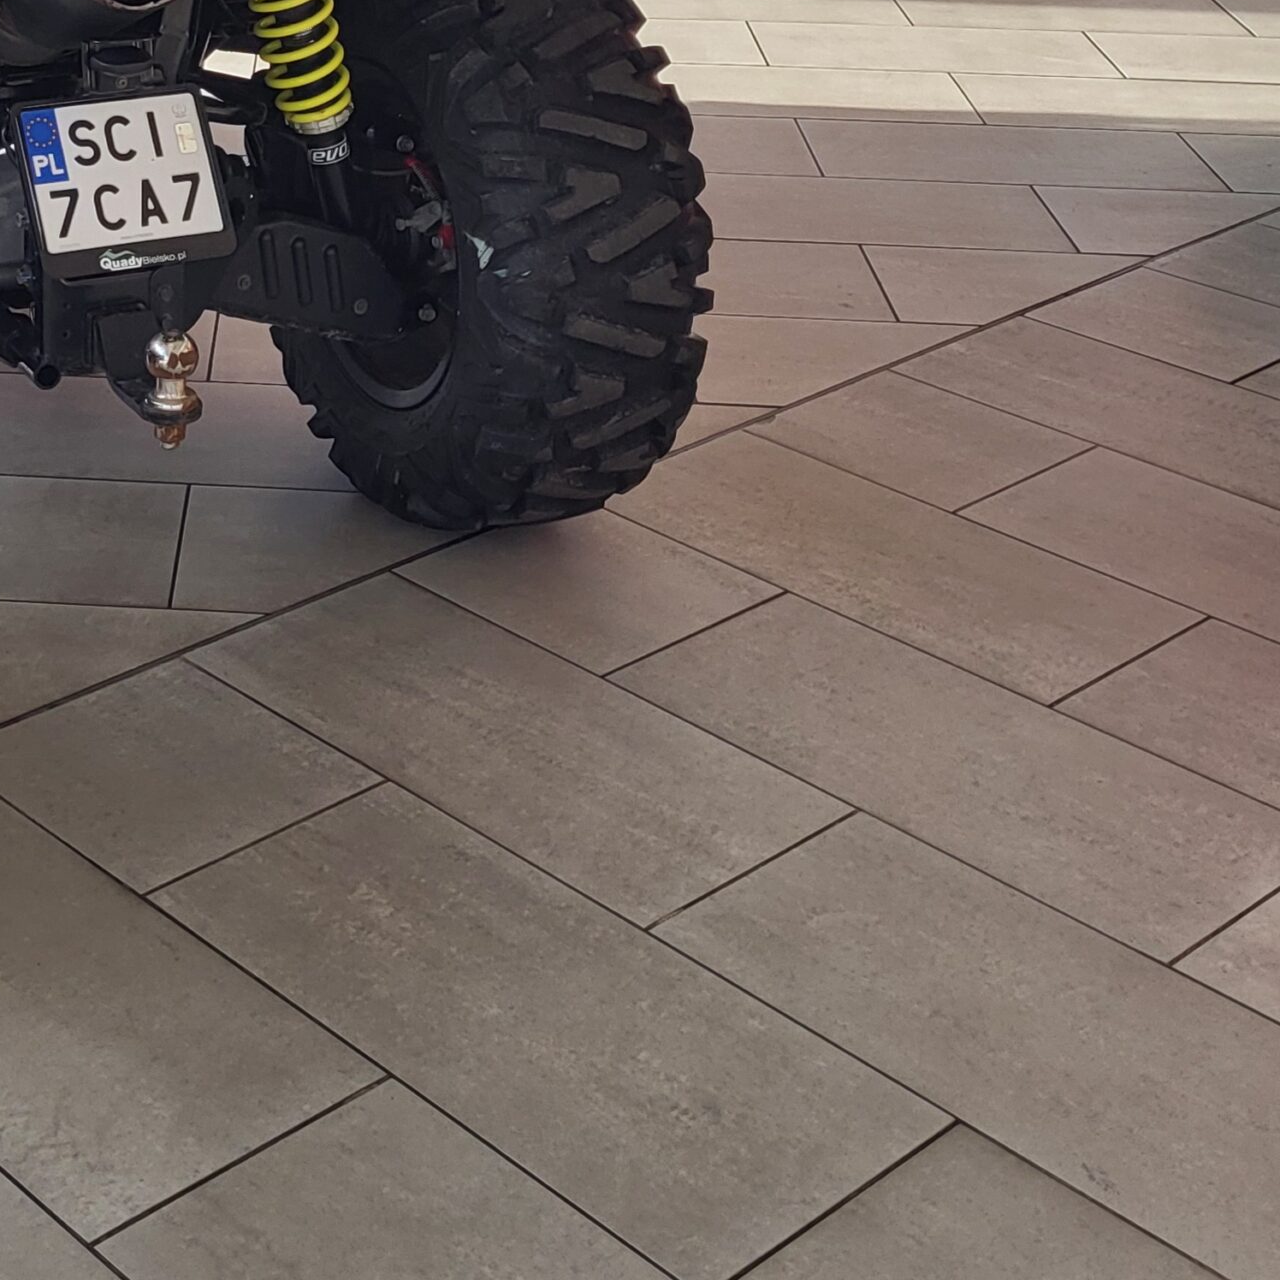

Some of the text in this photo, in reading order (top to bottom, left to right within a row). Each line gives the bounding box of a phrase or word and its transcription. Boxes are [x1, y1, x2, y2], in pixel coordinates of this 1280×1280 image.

[32, 154, 65, 177] PL
[68, 111, 164, 167] SCI
[49, 172, 200, 239] 7CA7
